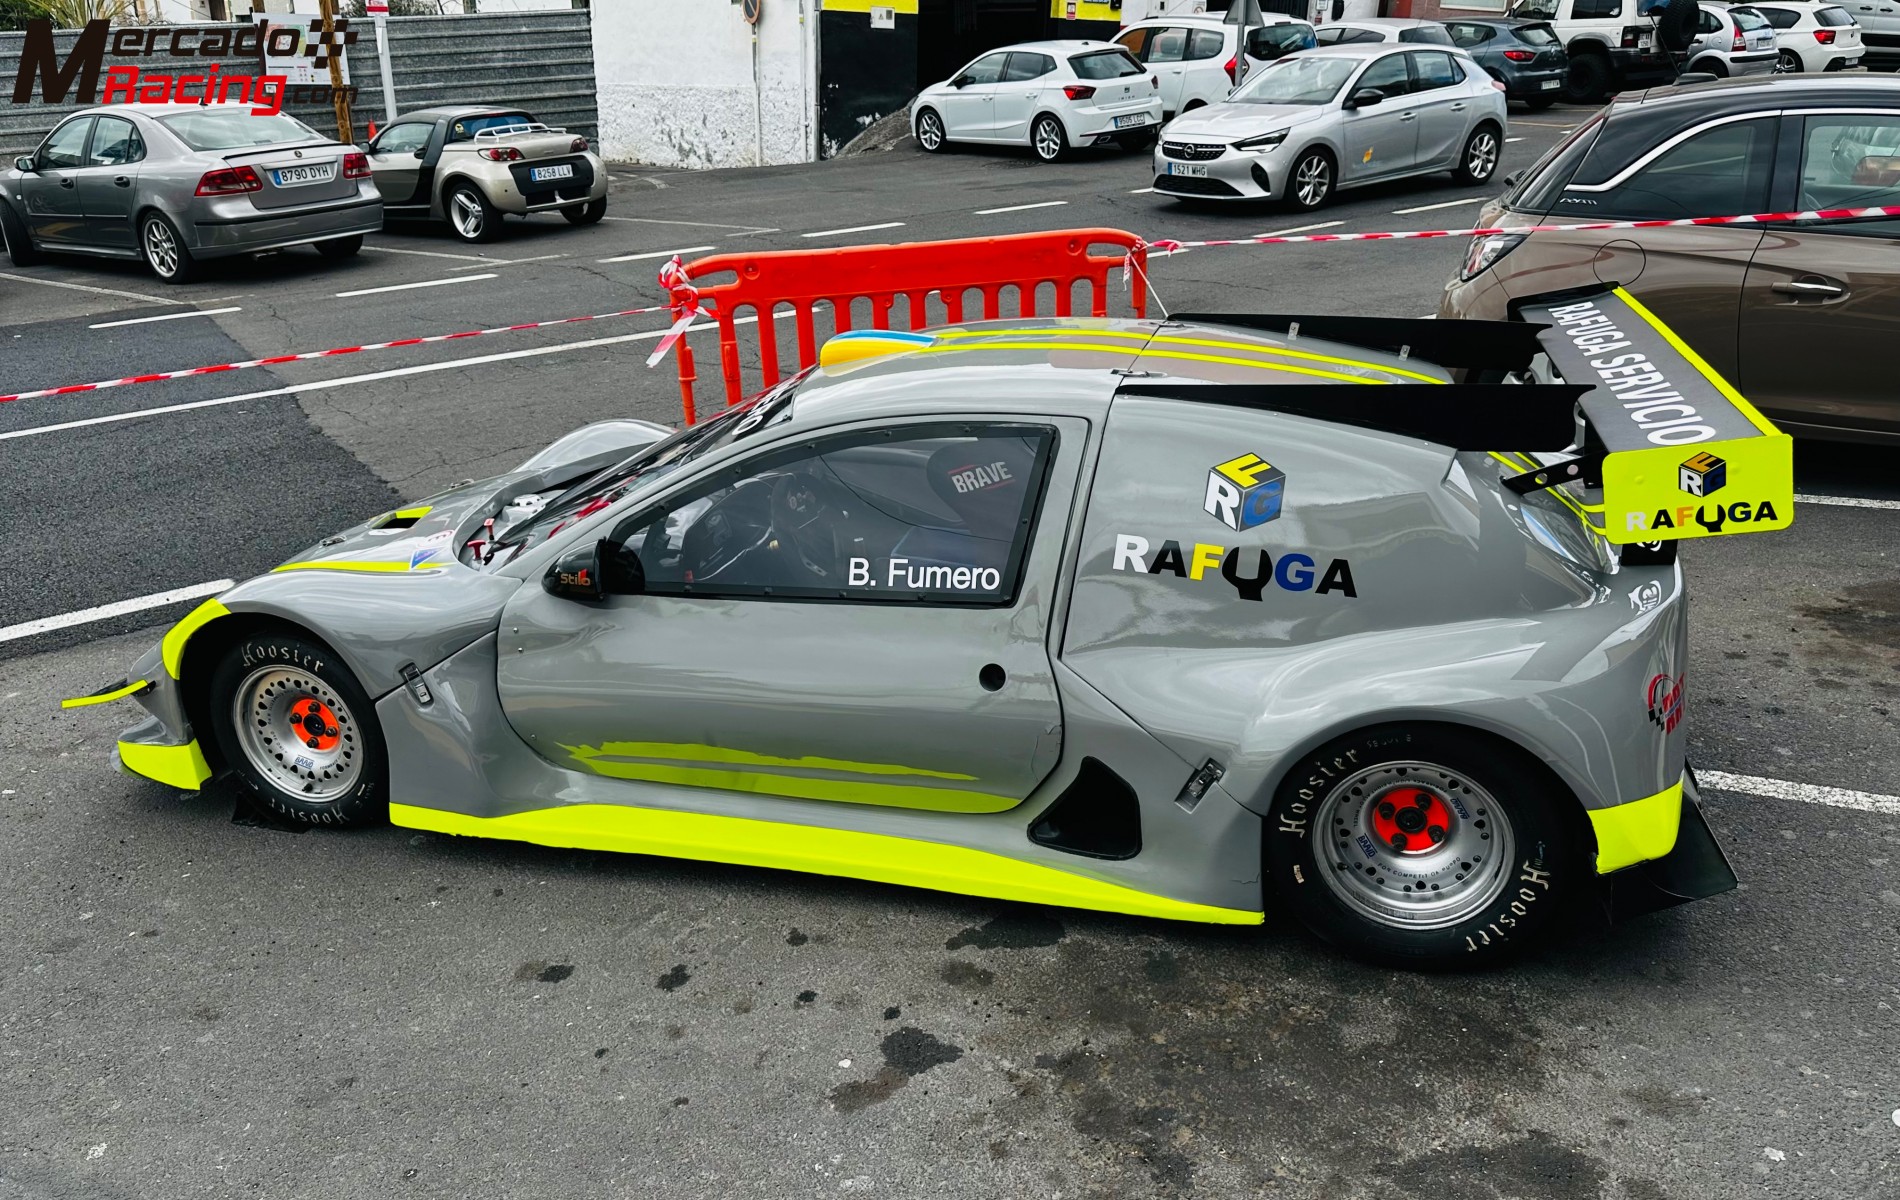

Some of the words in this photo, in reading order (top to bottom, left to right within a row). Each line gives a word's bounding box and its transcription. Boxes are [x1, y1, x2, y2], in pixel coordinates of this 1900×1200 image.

[281, 168, 307, 182] 8790
[309, 165, 330, 179] DYH
[537, 167, 556, 178] 8258
[1173, 164, 1190, 175] 1521
[1191, 165, 1206, 176] MHG
[1548, 302, 1632, 356] RAFUGA
[1590, 353, 1716, 445] SERVICIO
[951, 461, 1013, 493] BRAVE
[1626, 500, 1778, 533] RAFUGA
[560, 570, 591, 586] Stilo
[848, 557, 876, 587] B.
[887, 558, 1000, 590] Fumero
[1112, 533, 1358, 602] RAFUGA
[242, 642, 325, 673] Hoosier
[1279, 749, 1358, 839] Hoosier
[1465, 860, 1550, 952] Hoosier
